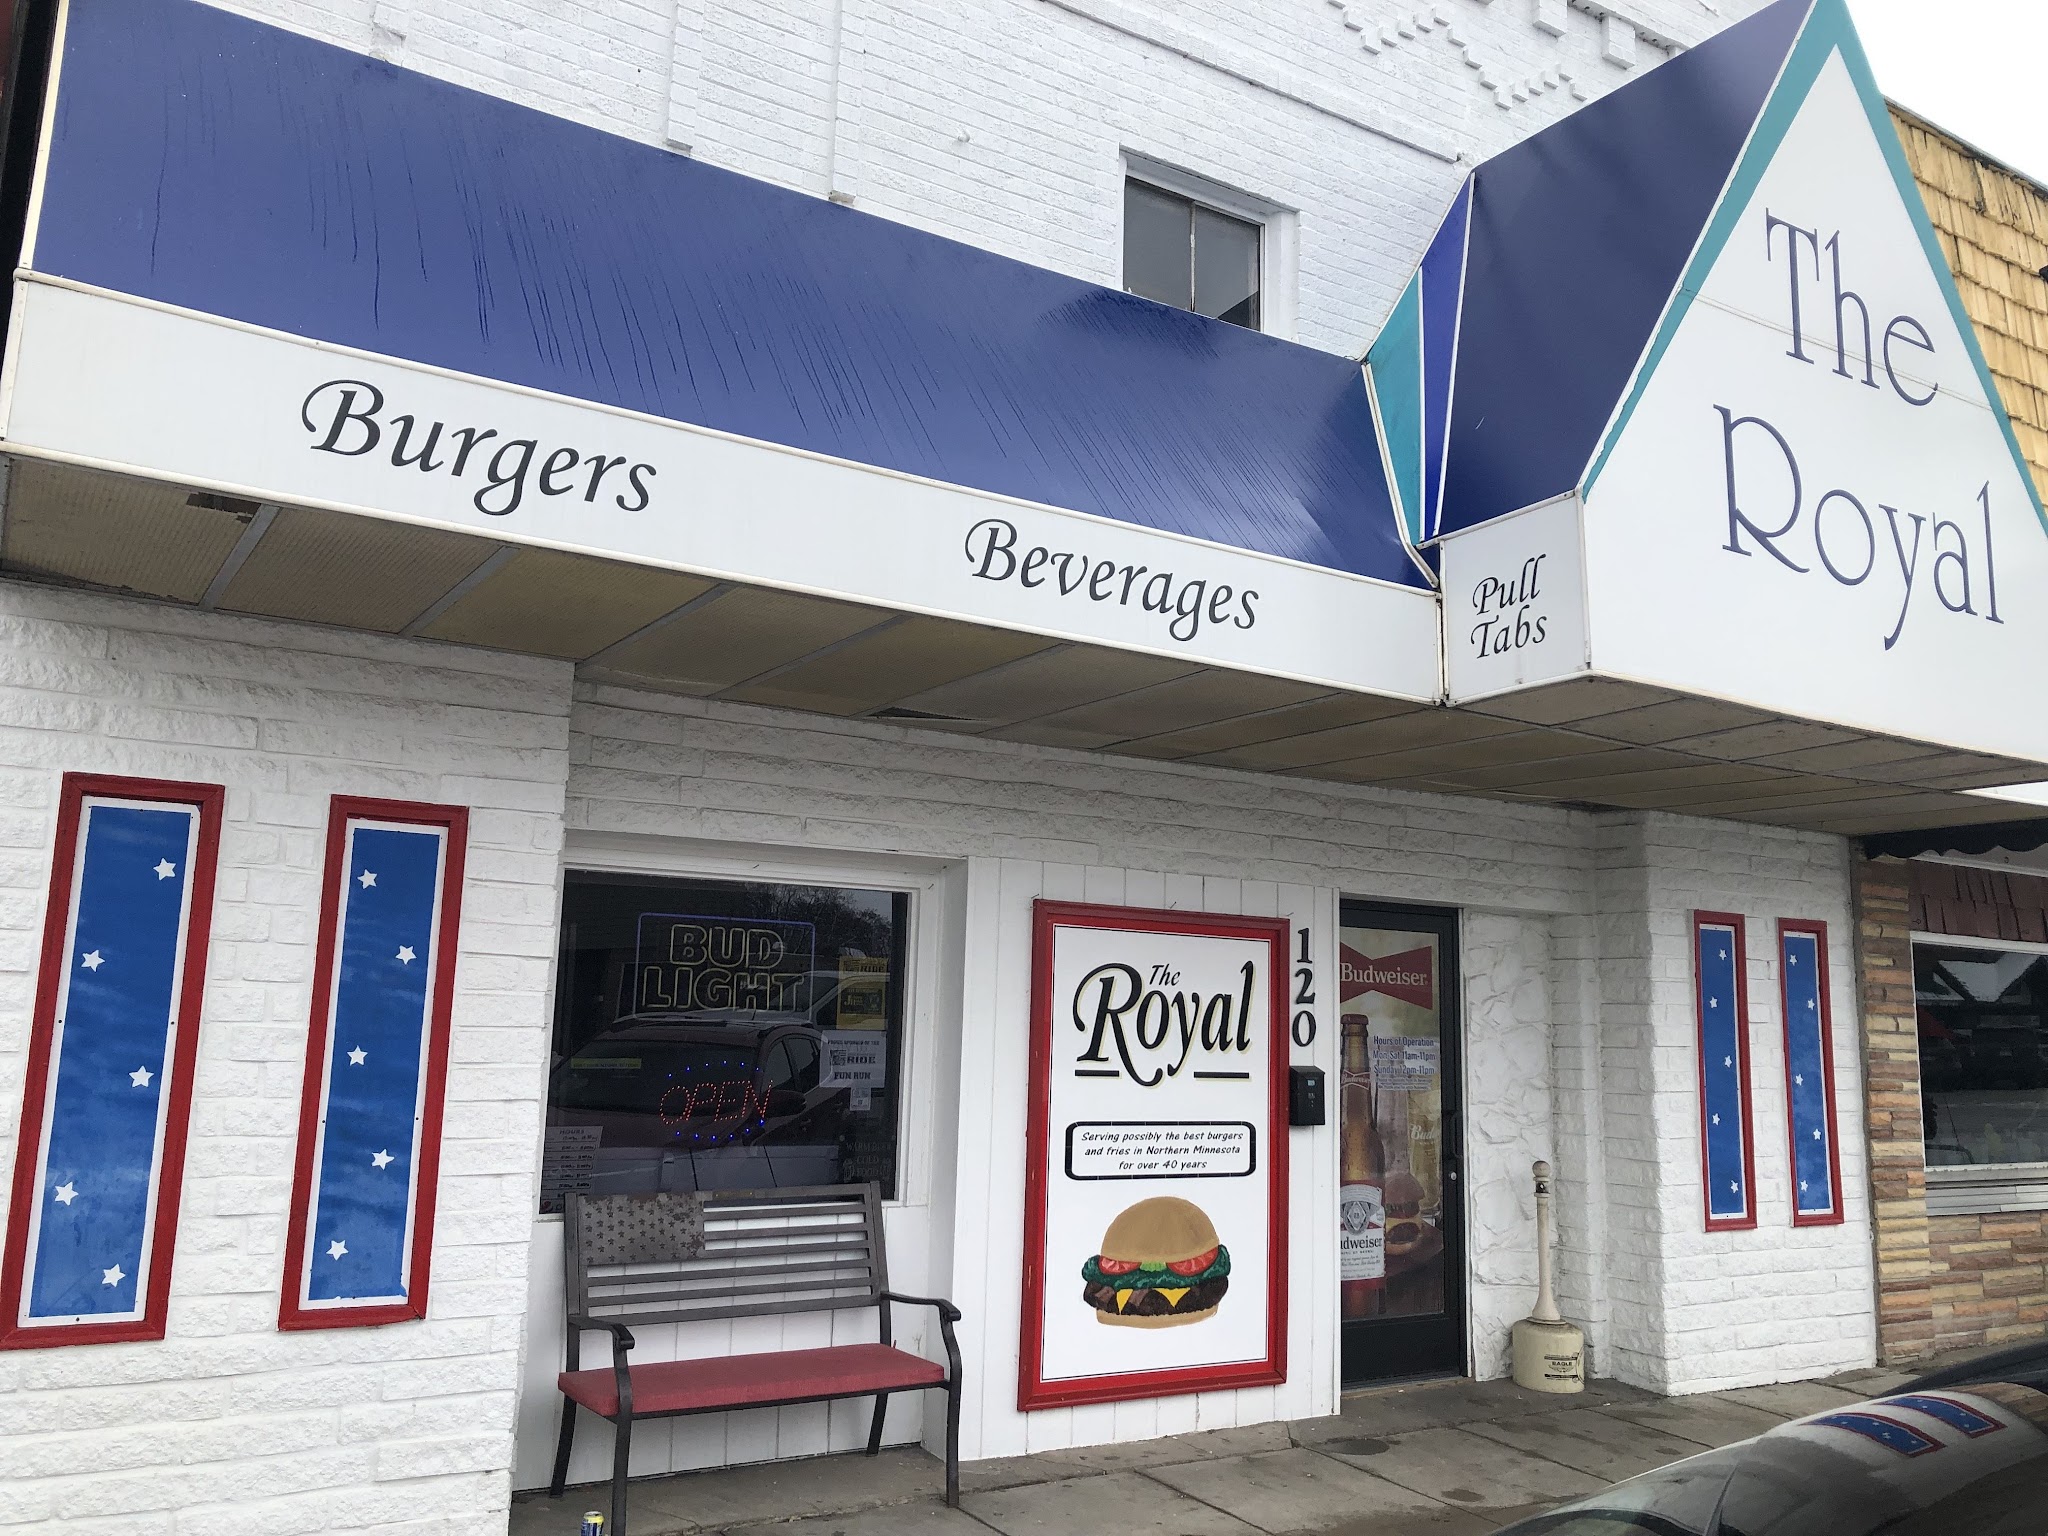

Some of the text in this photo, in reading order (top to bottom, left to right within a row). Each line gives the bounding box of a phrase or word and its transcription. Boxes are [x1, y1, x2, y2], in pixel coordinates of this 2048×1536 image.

[1765, 207, 1938, 407] The
[302, 379, 657, 516] Burgers
[1713, 404, 2005, 651] Royal
[964, 518, 1259, 642] Beverages
[1472, 553, 1547, 616] Pull
[1470, 609, 1547, 659] Tabs
[669, 924, 783, 969] BUD
[641, 966, 805, 1012] LIGHT
[1149, 963, 1181, 987] The
[1291, 927, 1317, 1048] 120
[1340, 962, 1427, 986] Budweiser
[1072, 960, 1254, 1087] Royal
[1373, 1035, 1435, 1048] Hours of Operation
[833, 1071, 872, 1080] FUN RUN
[1373, 1064, 1399, 1075] Sunday
[659, 1079, 774, 1125] OPEN
[1081, 1131, 1244, 1143] Serving possibly the best burgers
[1084, 1145, 1241, 1156] and fries in Northern Minnesota
[1118, 1160, 1208, 1171] for over 40 years
